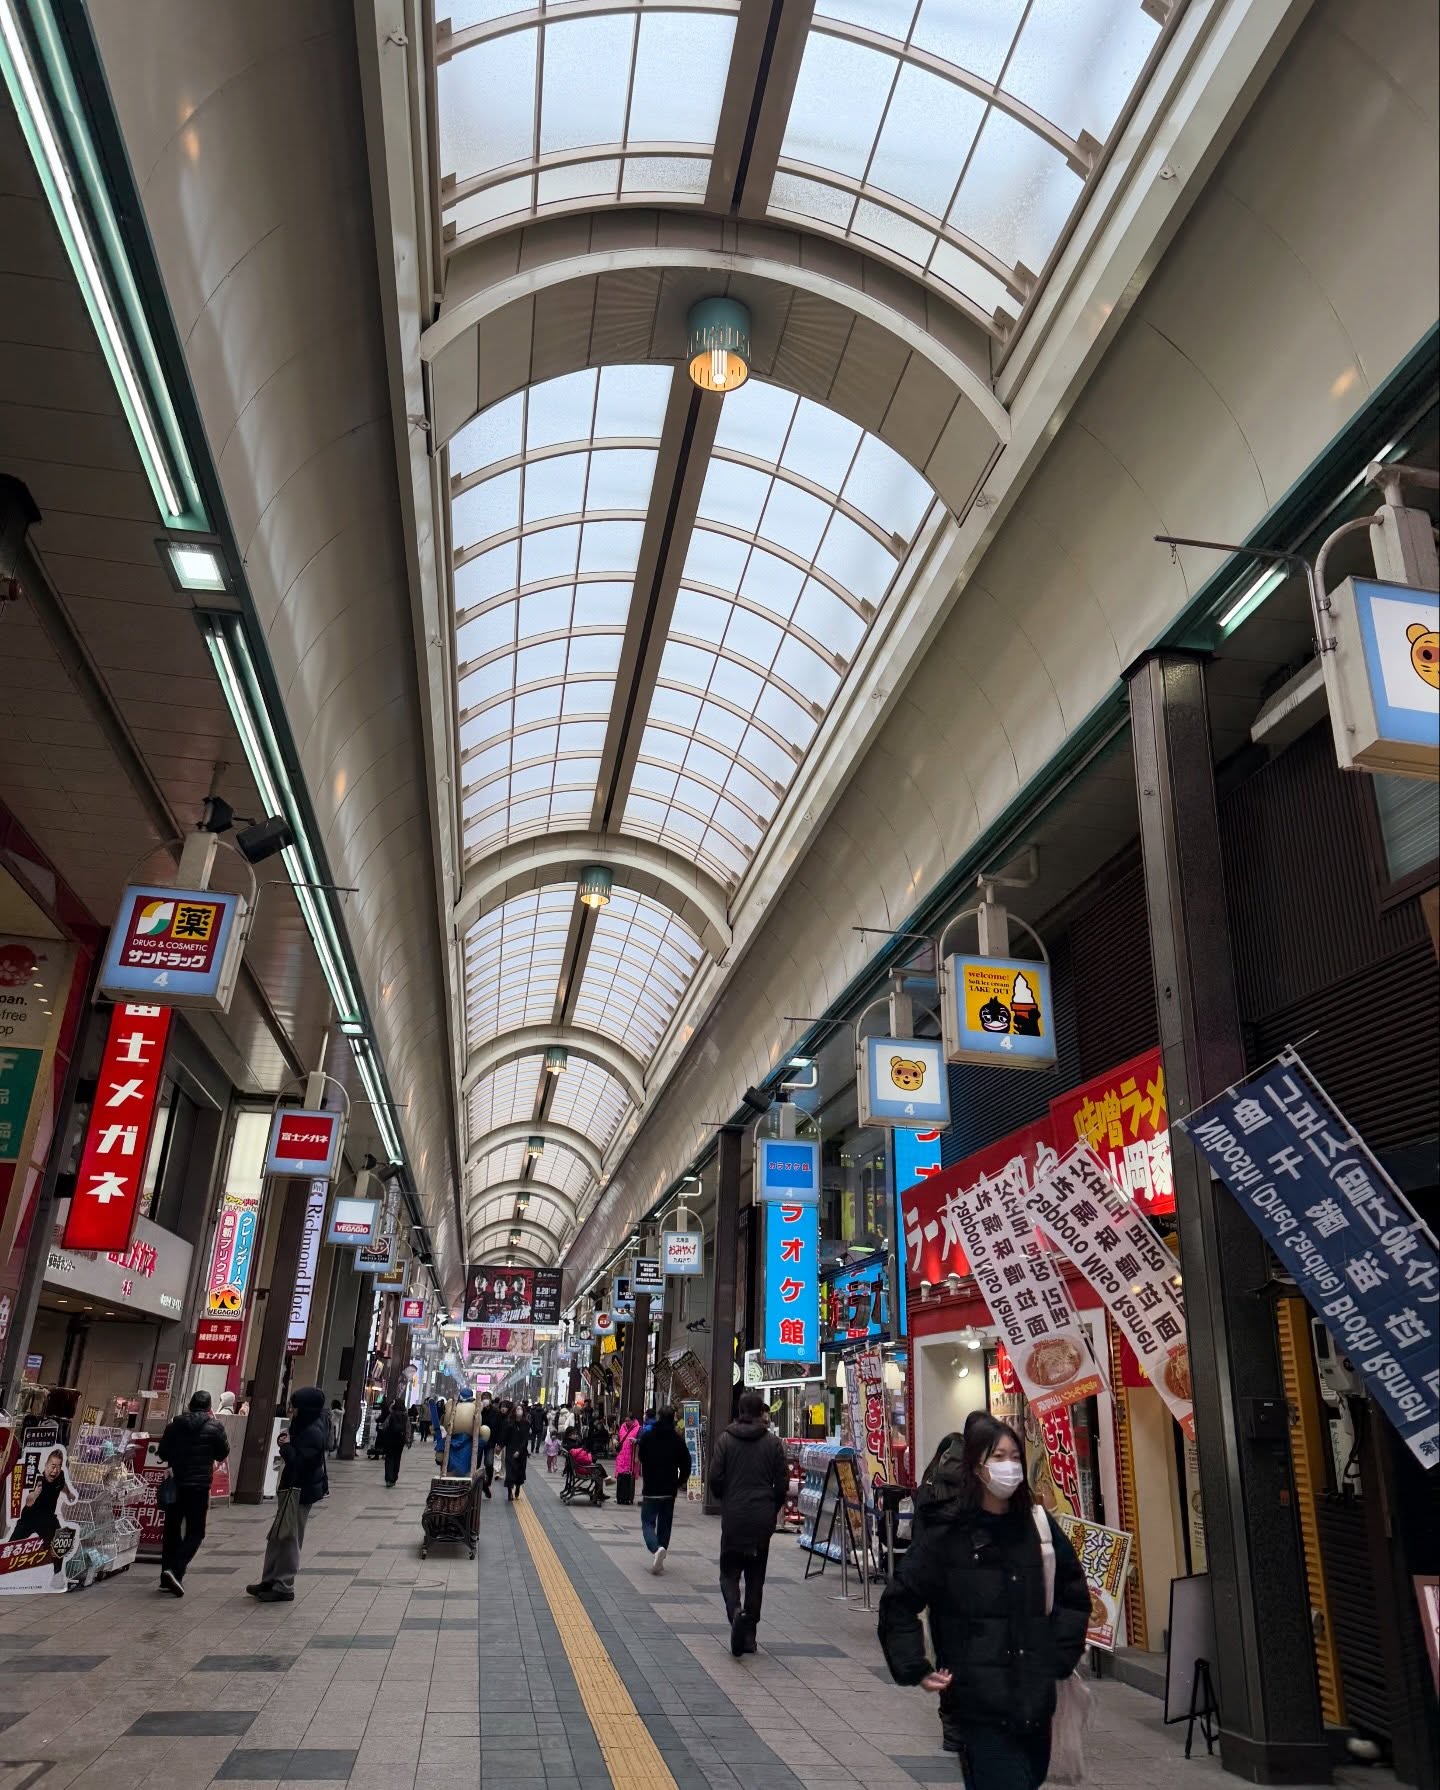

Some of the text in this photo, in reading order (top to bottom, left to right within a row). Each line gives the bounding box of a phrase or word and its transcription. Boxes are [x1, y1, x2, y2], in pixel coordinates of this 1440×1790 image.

[175, 907, 212, 937] 薬
[133, 938, 156, 947] DRUG
[166, 941, 208, 952] COSMETIC
[128, 949, 207, 968] サンドラッグ
[153, 971, 168, 987] 4
[969, 985, 1009, 995] TAKE OUT
[1000, 1036, 1012, 1050] 4
[904, 1103, 915, 1116] 4
[281, 1132, 329, 1143] 富士メガネ
[295, 1161, 304, 1170] 4
[768, 1161, 811, 1172] カラオケ館
[784, 1187, 793, 1198] 4
[297, 1204, 323, 1281] Richmond
[231, 1216, 254, 1286] クレーンゲーム
[290, 1285, 311, 1324] Hotel
[208, 1308, 240, 1316] VEGAGIO
[198, 1352, 232, 1360] 富士メガネ
[144, 1471, 165, 1483] 認定
[0, 1538, 44, 1560] 着るだけ
